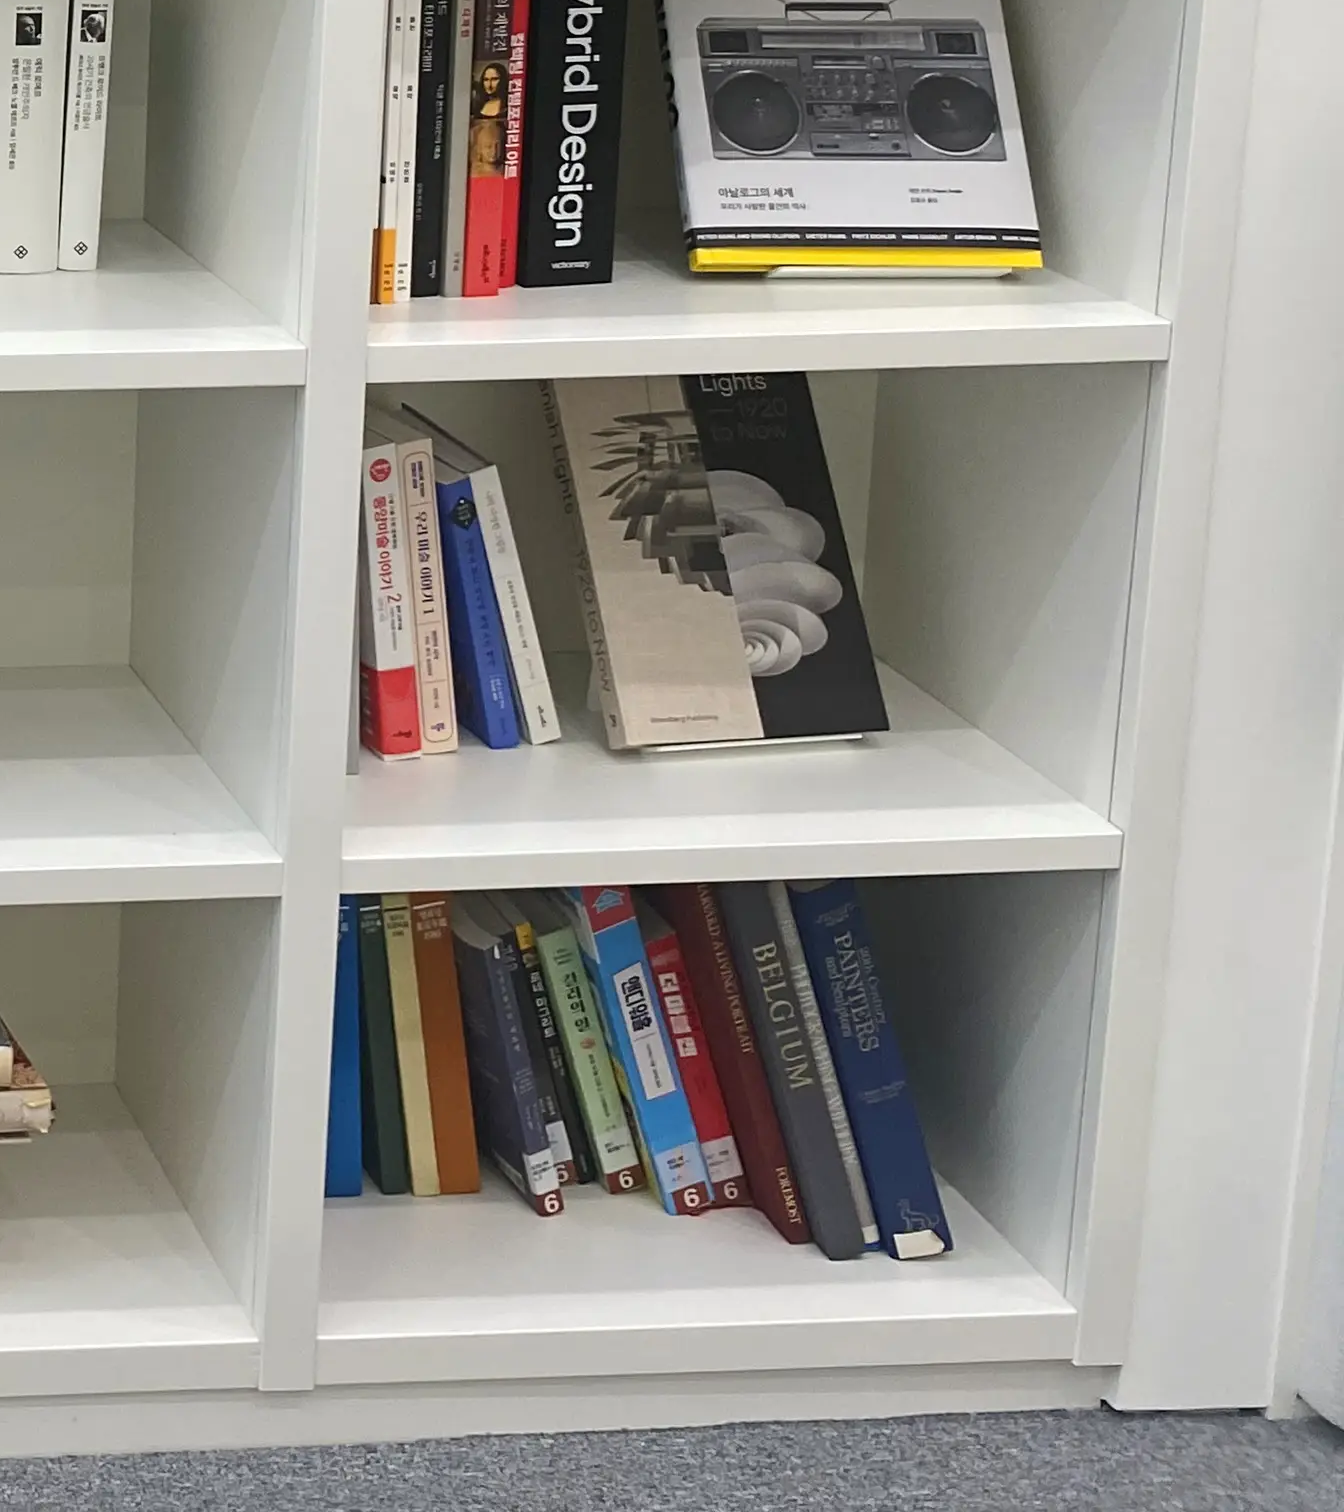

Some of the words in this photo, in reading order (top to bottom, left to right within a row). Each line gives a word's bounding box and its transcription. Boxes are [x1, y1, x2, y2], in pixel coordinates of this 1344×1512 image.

[504, 150, 519, 180] 아트
[548, 103, 598, 248] Design
[718, 187, 771, 198] 아날로그의
[773, 187, 794, 198] 세계
[699, 374, 767, 396] Lights
[377, 551, 393, 593] 이야기
[415, 565, 438, 604] 이야기
[622, 974, 653, 1032] 앤디워홀
[826, 931, 884, 1054] PAINTERS
[747, 940, 818, 1091] BELGIUM
[618, 1170, 634, 1188] 6
[723, 1181, 738, 1200] 6
[773, 1164, 805, 1227] FOREMOST
[544, 1194, 559, 1213] 6
[683, 1189, 700, 1208] 6
